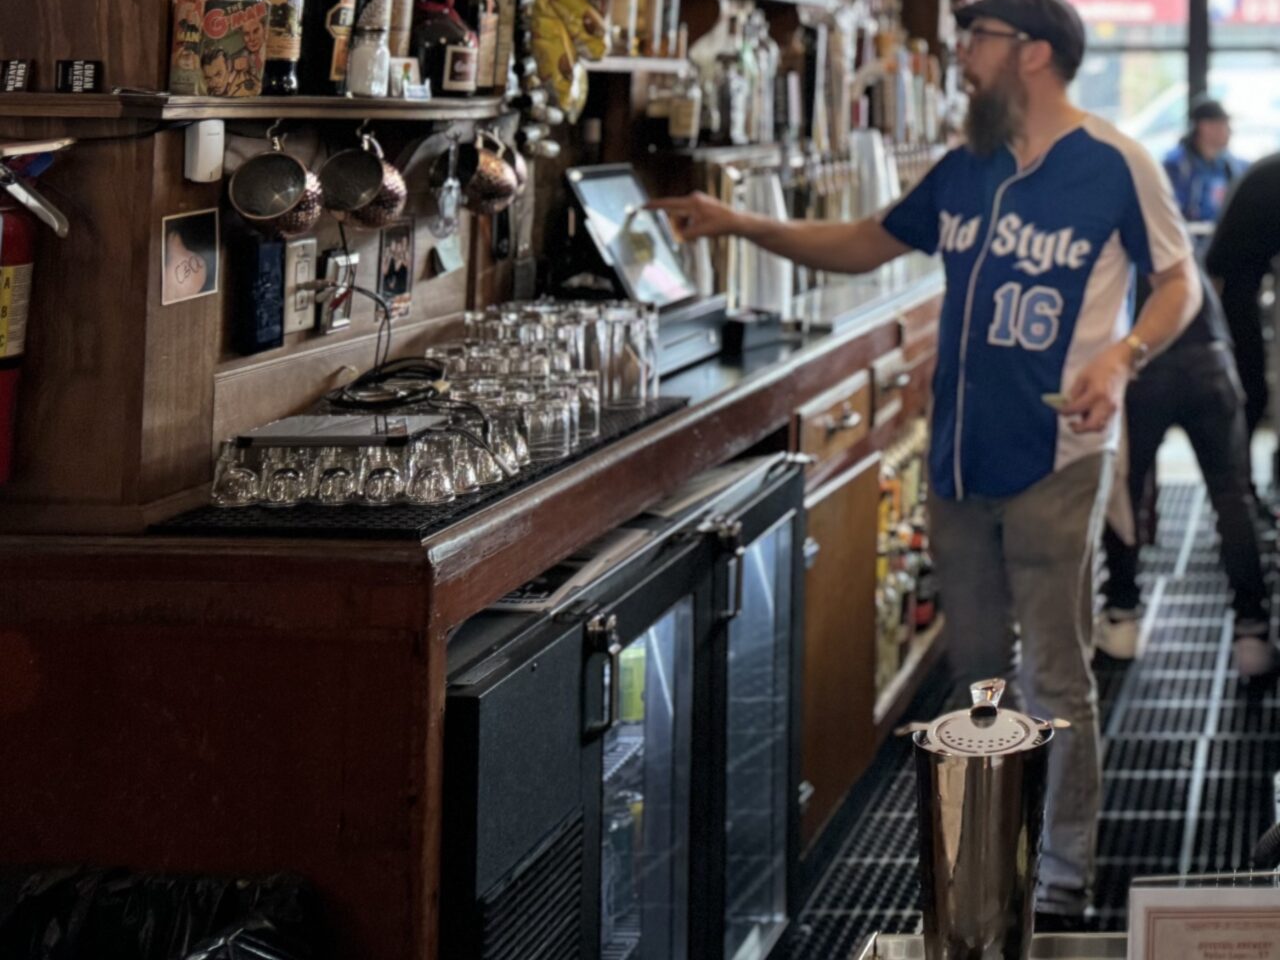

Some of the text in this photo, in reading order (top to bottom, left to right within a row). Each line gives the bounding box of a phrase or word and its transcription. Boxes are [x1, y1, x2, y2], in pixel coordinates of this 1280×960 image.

[226, 2, 243, 15] THE
[5, 60, 19, 92] TAVERN
[15, 63, 26, 88] GMAN
[72, 60, 84, 93] TAVERN
[83, 64, 95, 89] GMAN
[991, 212, 1092, 276] Style
[987, 281, 1064, 351] 16
